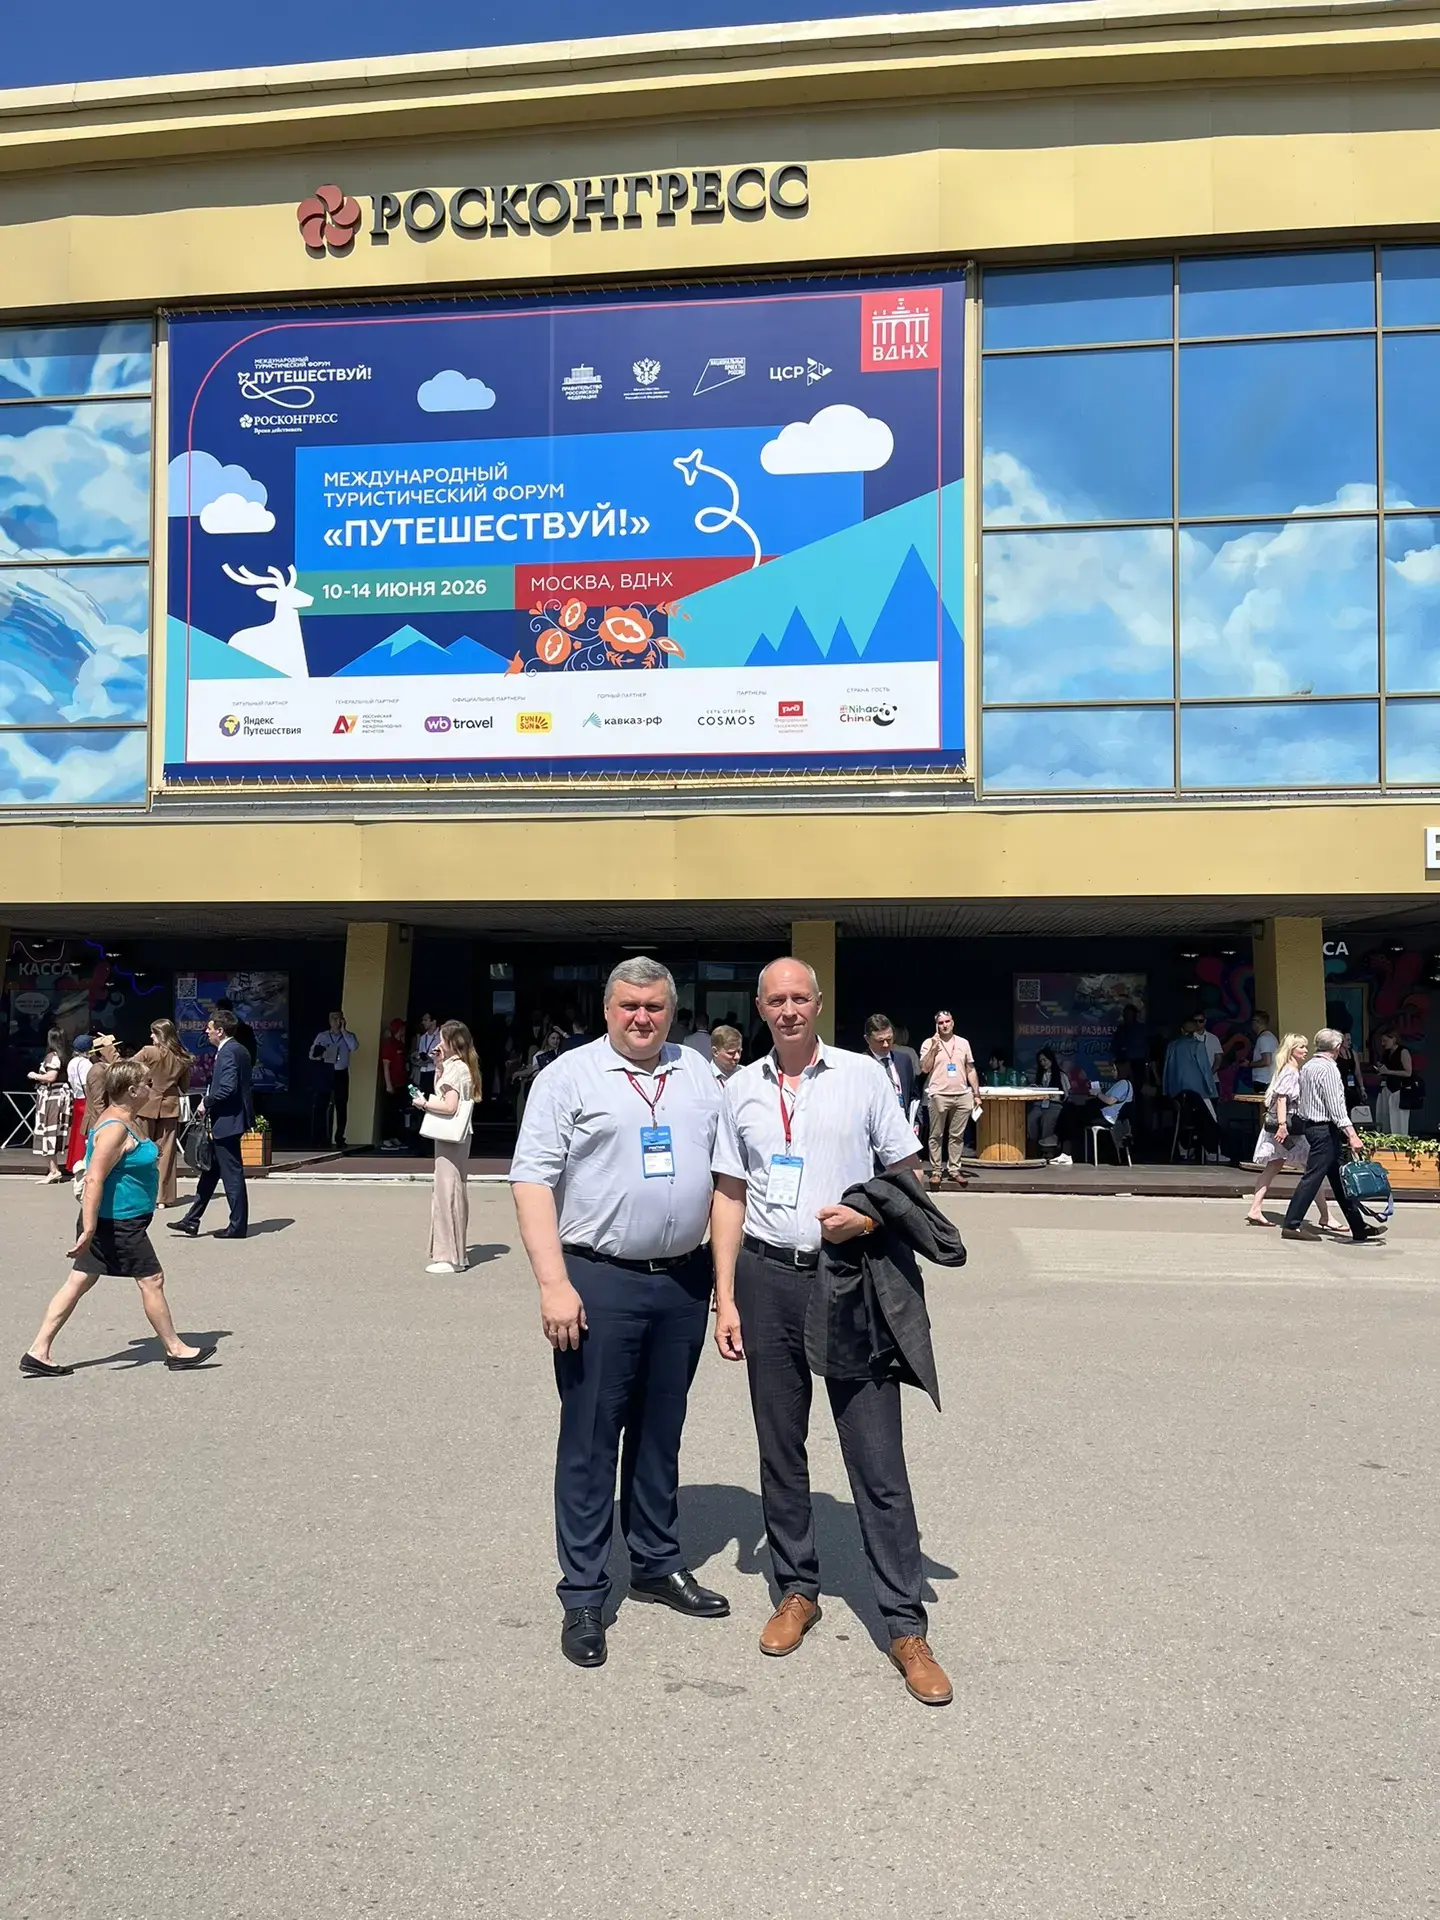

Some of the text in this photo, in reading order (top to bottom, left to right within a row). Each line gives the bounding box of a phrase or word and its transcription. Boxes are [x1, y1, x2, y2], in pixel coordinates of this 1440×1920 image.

[369, 164, 809, 240] РОСКОНГРЕСС
[873, 343, 928, 361] ВДНХ
[254, 356, 309, 365] МЕЖДУНАРОДНЫЙ
[254, 365, 372, 384] ПУТЕШЕСТВУЙ!
[769, 366, 804, 381] ЦСР
[254, 413, 338, 426] РОСКОНГРЕСС
[324, 462, 508, 487] МЕЖДУНАРОДНЫЙ
[324, 483, 565, 508] ТУРИСТИЧЕСКИЙ ФОРУМ
[323, 502, 651, 547] «ПУТЕШЕСТВУЙ!»
[531, 571, 673, 592] МОСКВА, ВДНХ
[322, 579, 487, 599] 10-14 ИЮНЯ 2026
[849, 704, 879, 714] Nihao
[243, 716, 274, 726] Яндекс
[427, 716, 493, 730] wb travel
[697, 715, 755, 726] COSMOS
[840, 713, 872, 723] China
[243, 726, 302, 737] Путешествия
[18, 962, 73, 976] КАССА
